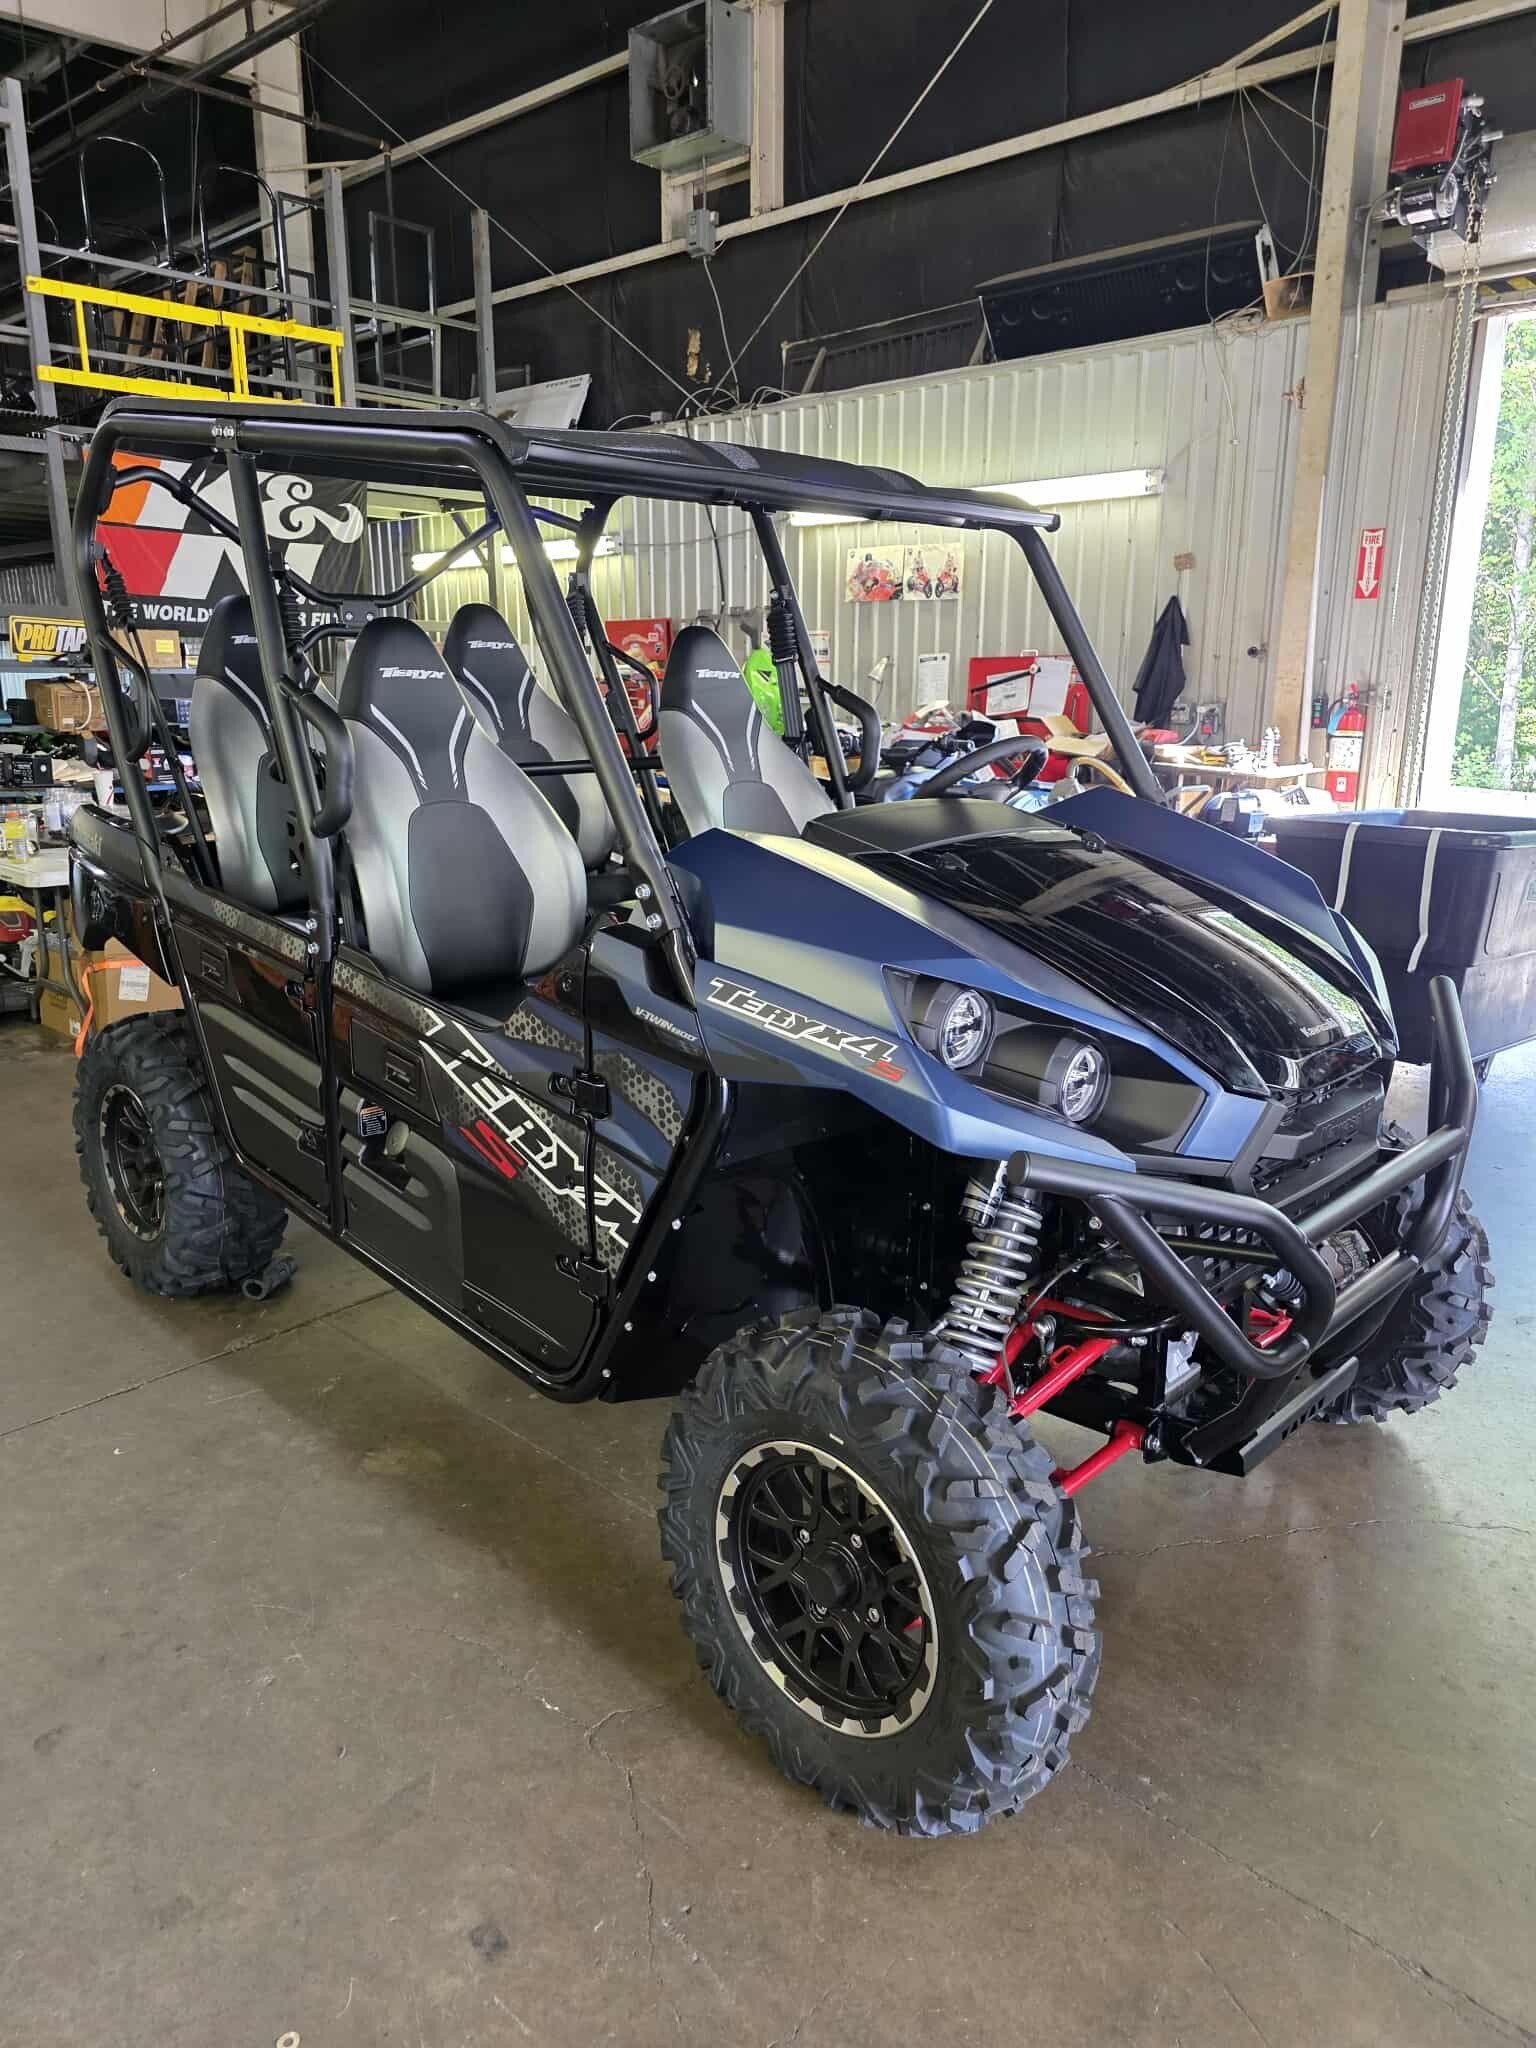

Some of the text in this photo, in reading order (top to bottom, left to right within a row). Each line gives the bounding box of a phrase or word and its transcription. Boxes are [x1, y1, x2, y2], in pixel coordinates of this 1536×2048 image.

[1364, 534, 1381, 545] FIRE
[102, 599, 138, 619] TE
[142, 603, 213, 623] WORLD'
[19, 623, 88, 653] PROTAP
[706, 976, 898, 1063] TERYX4
